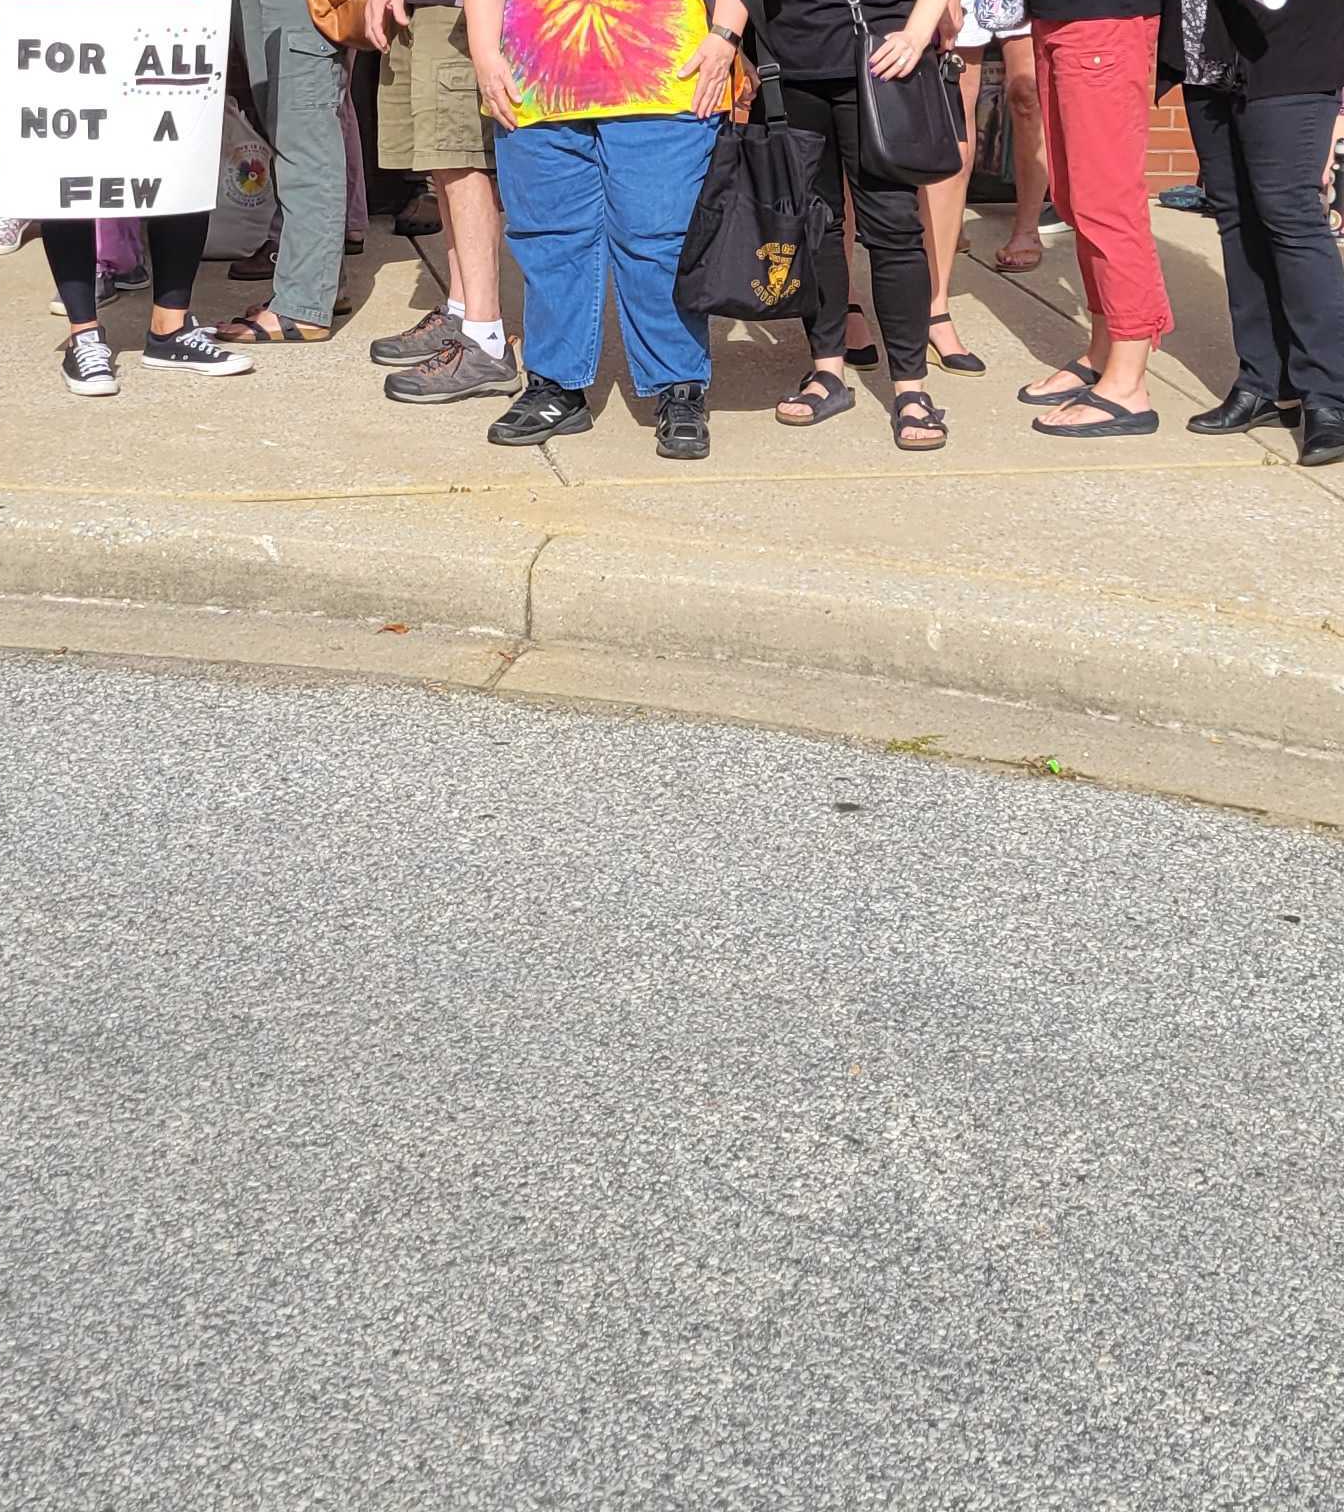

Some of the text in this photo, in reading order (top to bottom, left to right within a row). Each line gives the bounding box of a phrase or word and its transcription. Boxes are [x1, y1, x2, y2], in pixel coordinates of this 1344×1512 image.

[17, 38, 107, 75] FOR
[20, 106, 180, 142] NOT A
[59, 176, 162, 209] FEW
